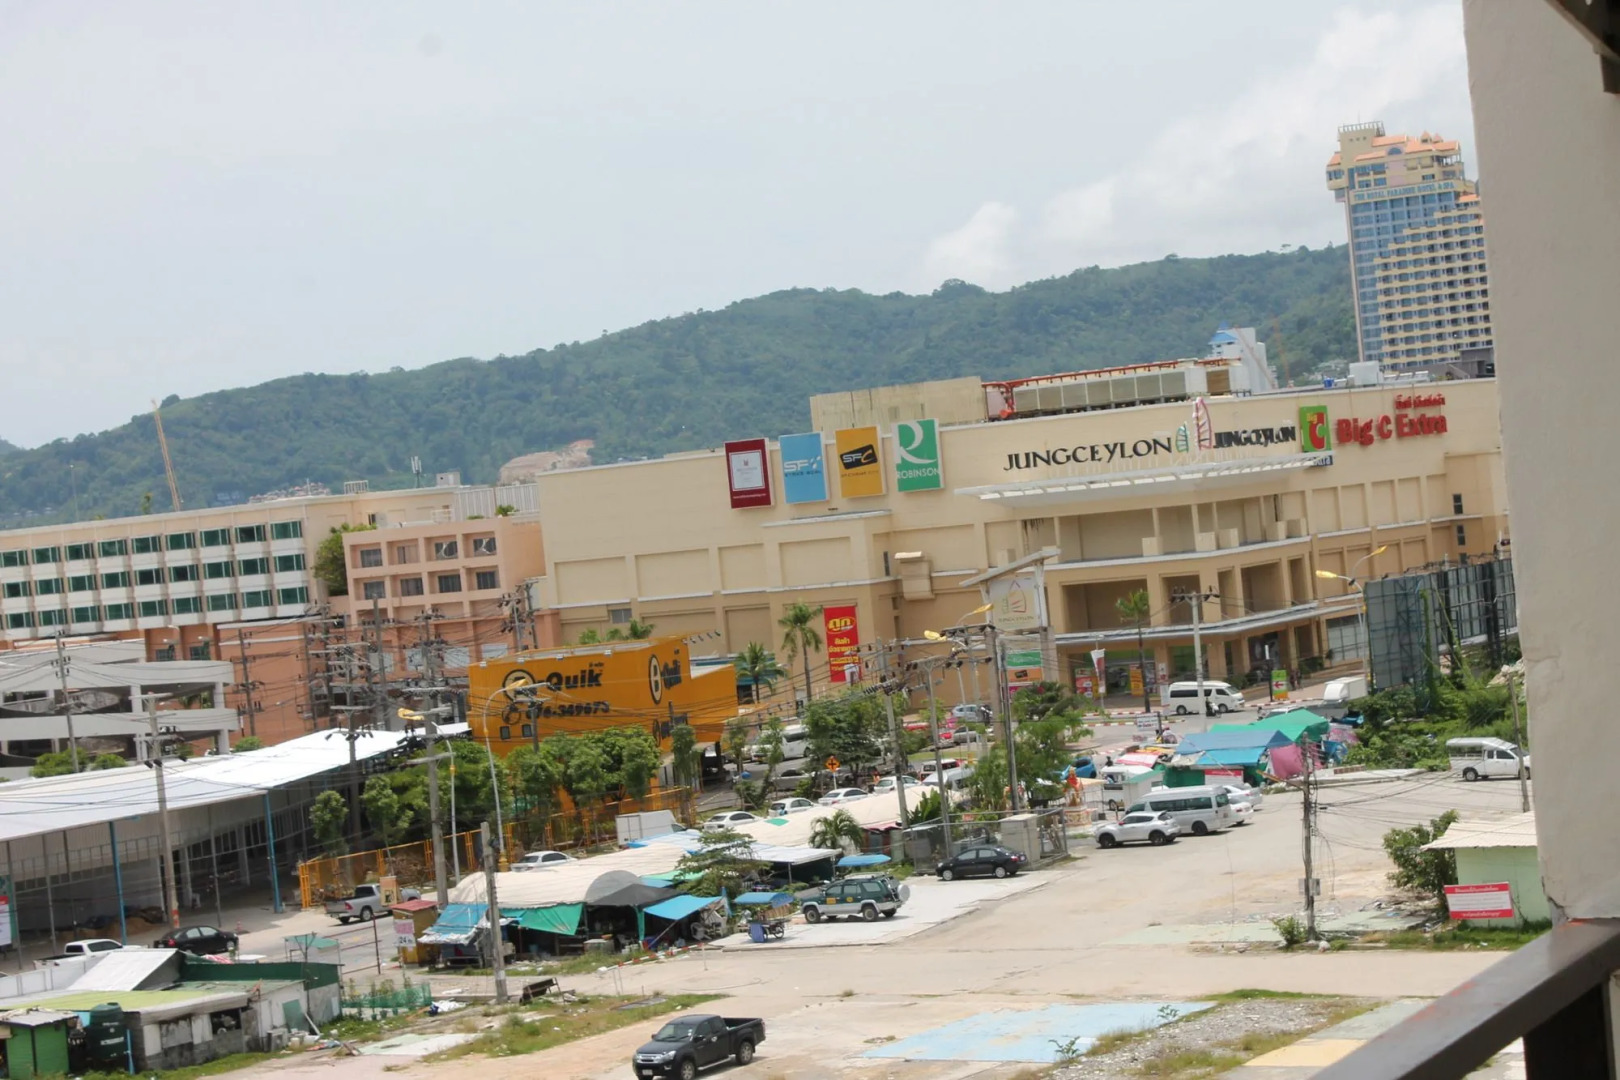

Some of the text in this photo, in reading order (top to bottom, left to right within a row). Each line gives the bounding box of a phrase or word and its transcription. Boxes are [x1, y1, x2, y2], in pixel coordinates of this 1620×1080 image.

[1213, 425, 1297, 449] JUNGCEYLON
[1336, 413, 1447, 447] Big C Extra
[1003, 437, 1173, 471] JUNGCEYLON
[896, 467, 940, 479] ROBINSON
